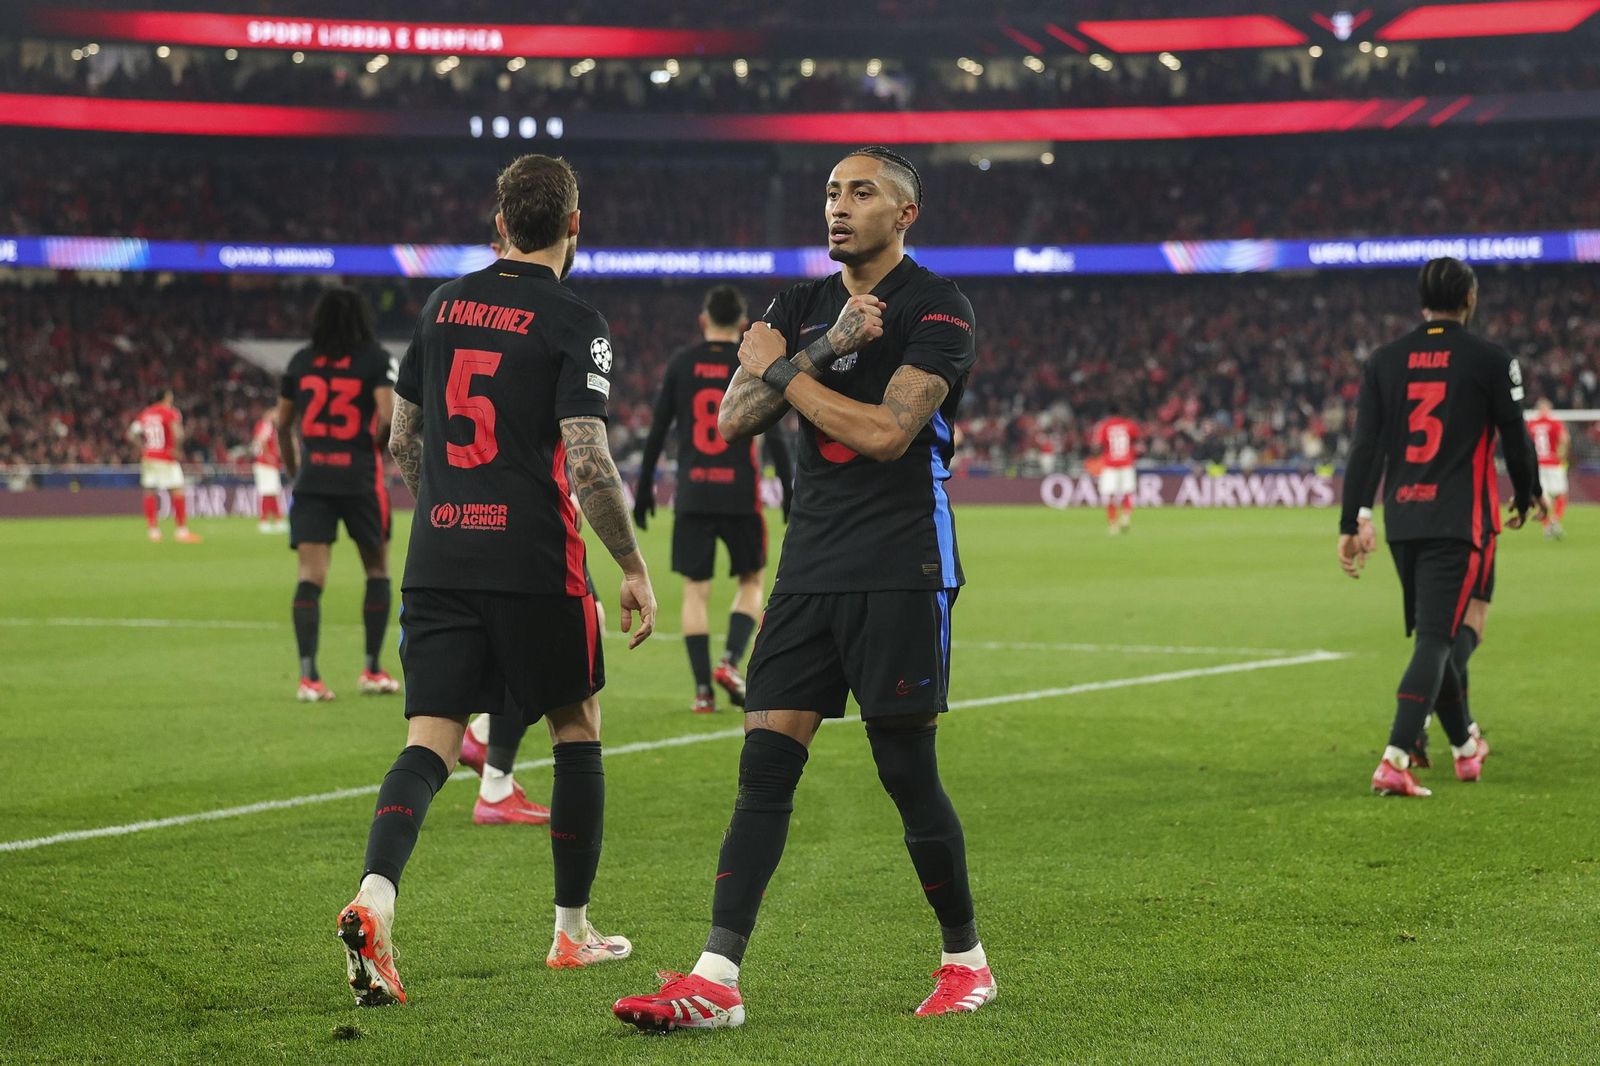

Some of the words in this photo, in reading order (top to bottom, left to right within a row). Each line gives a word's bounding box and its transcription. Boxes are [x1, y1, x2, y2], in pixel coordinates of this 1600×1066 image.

[247, 20, 313, 43] SPORT
[318, 23, 391, 49] LISBOA
[414, 27, 503, 51] BENFICA
[448, 299, 535, 335] MARTINEZ
[921, 313, 971, 331] AMBILIGHT
[1407, 350, 1451, 369] BALDE
[298, 373, 363, 441] 23
[444, 348, 503, 469] 5
[691, 387, 731, 456] 8
[1404, 381, 1448, 464] 3
[1040, 472, 1164, 510] QAR
[1174, 472, 1336, 509] AIRWAYS
[461, 514, 507, 525] ACNUR
[463, 504, 508, 515] UNHCR
